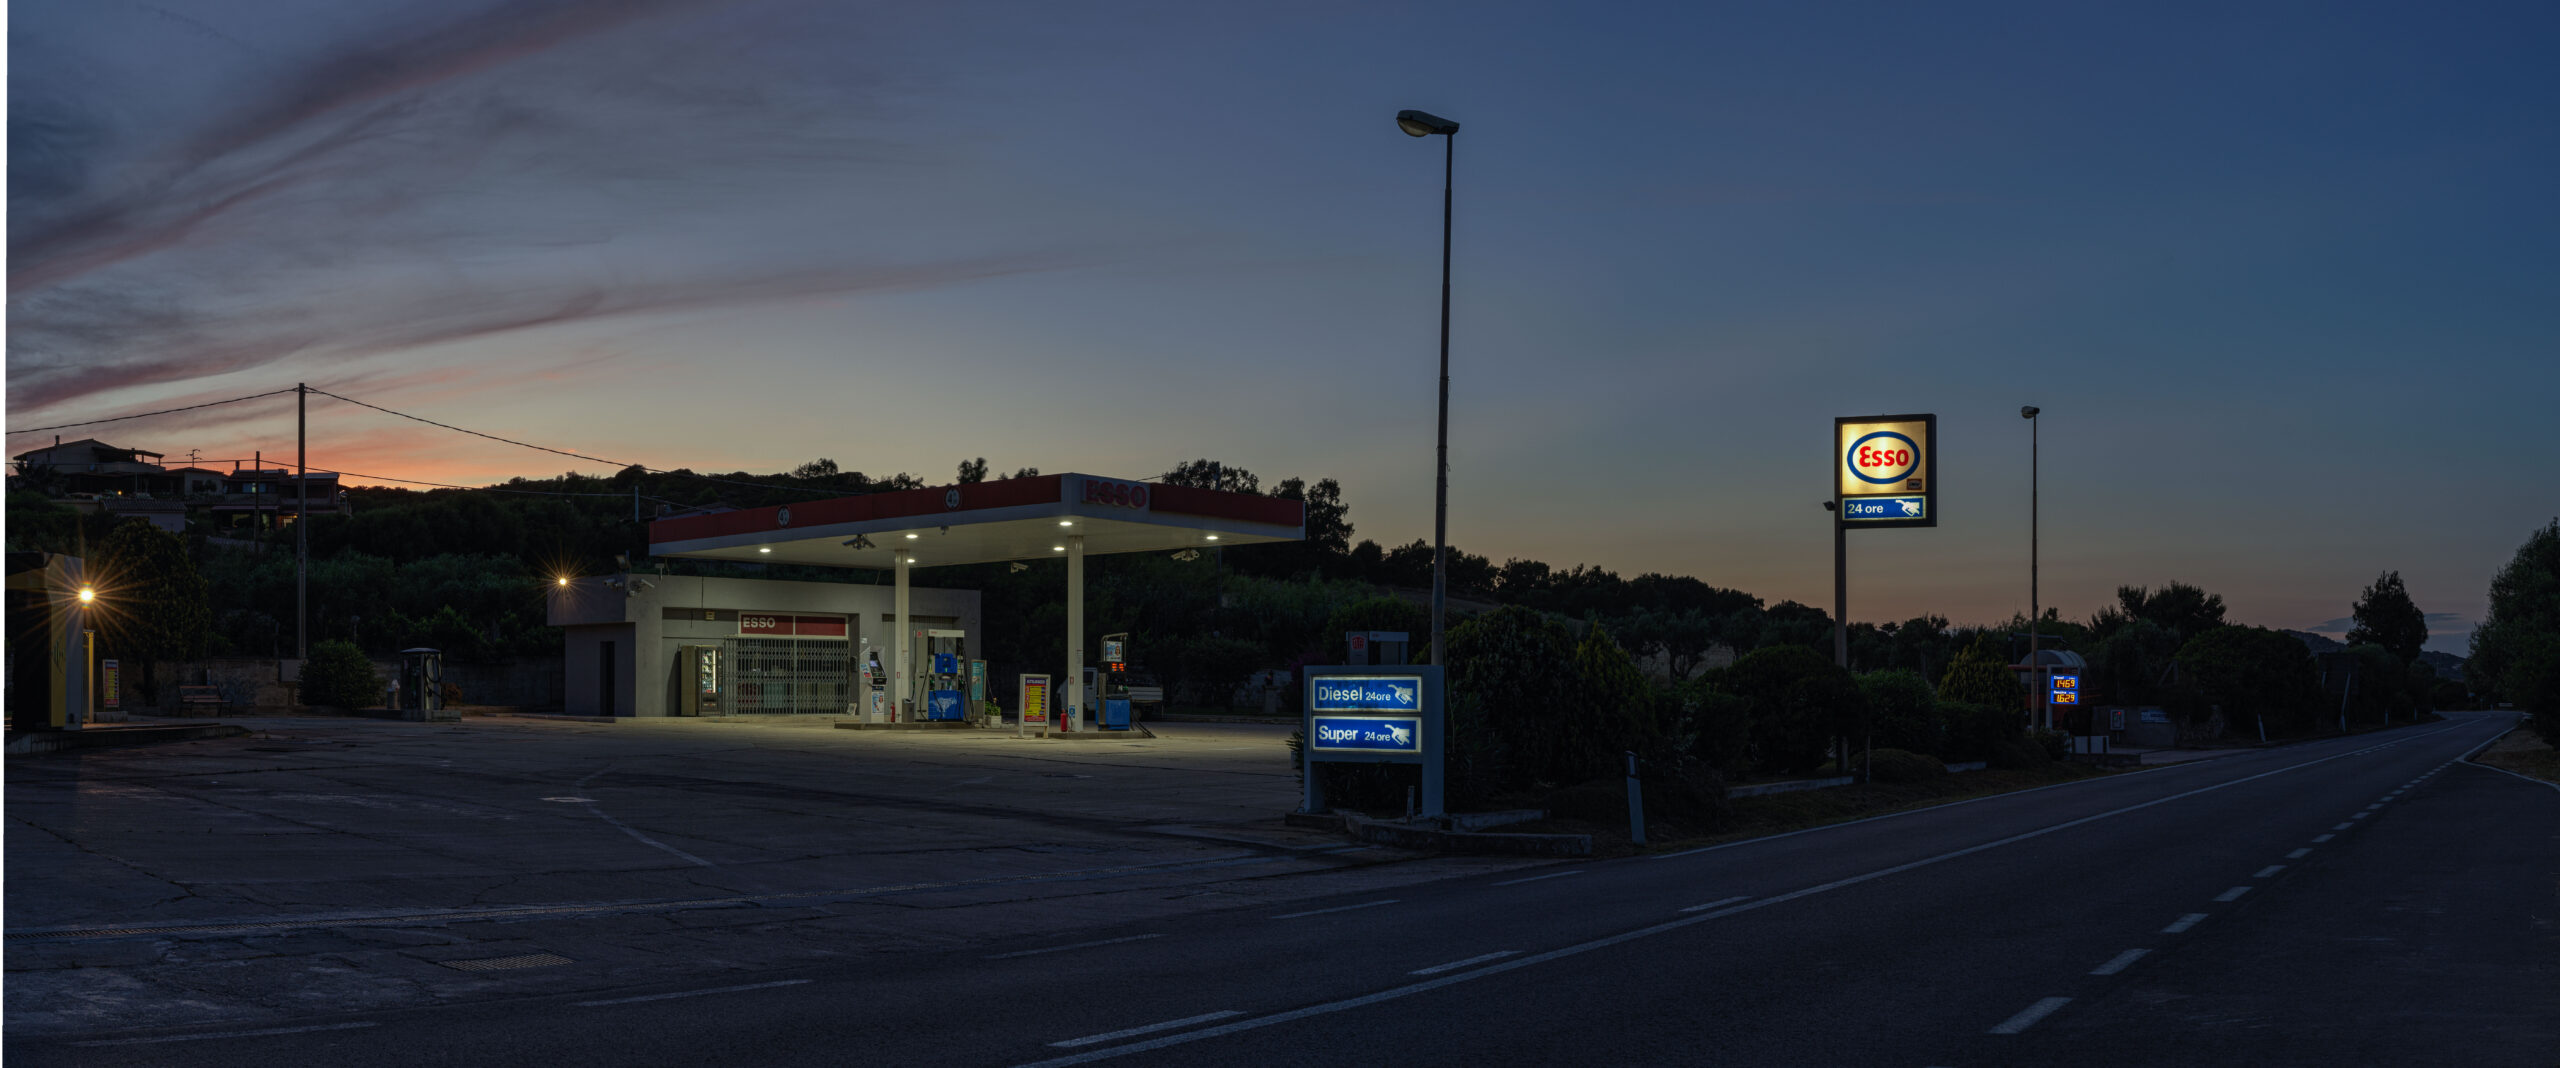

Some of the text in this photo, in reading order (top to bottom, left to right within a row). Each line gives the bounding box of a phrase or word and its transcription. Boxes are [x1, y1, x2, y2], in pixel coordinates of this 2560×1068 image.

[1859, 446, 1909, 467] Esso
[1086, 480, 1147, 507] ESSO
[1847, 503, 1884, 514] 24 ore
[743, 616, 776, 629] ESSO
[1318, 686, 1363, 701] Diesel
[1318, 725, 1391, 744] Super 24 ore
